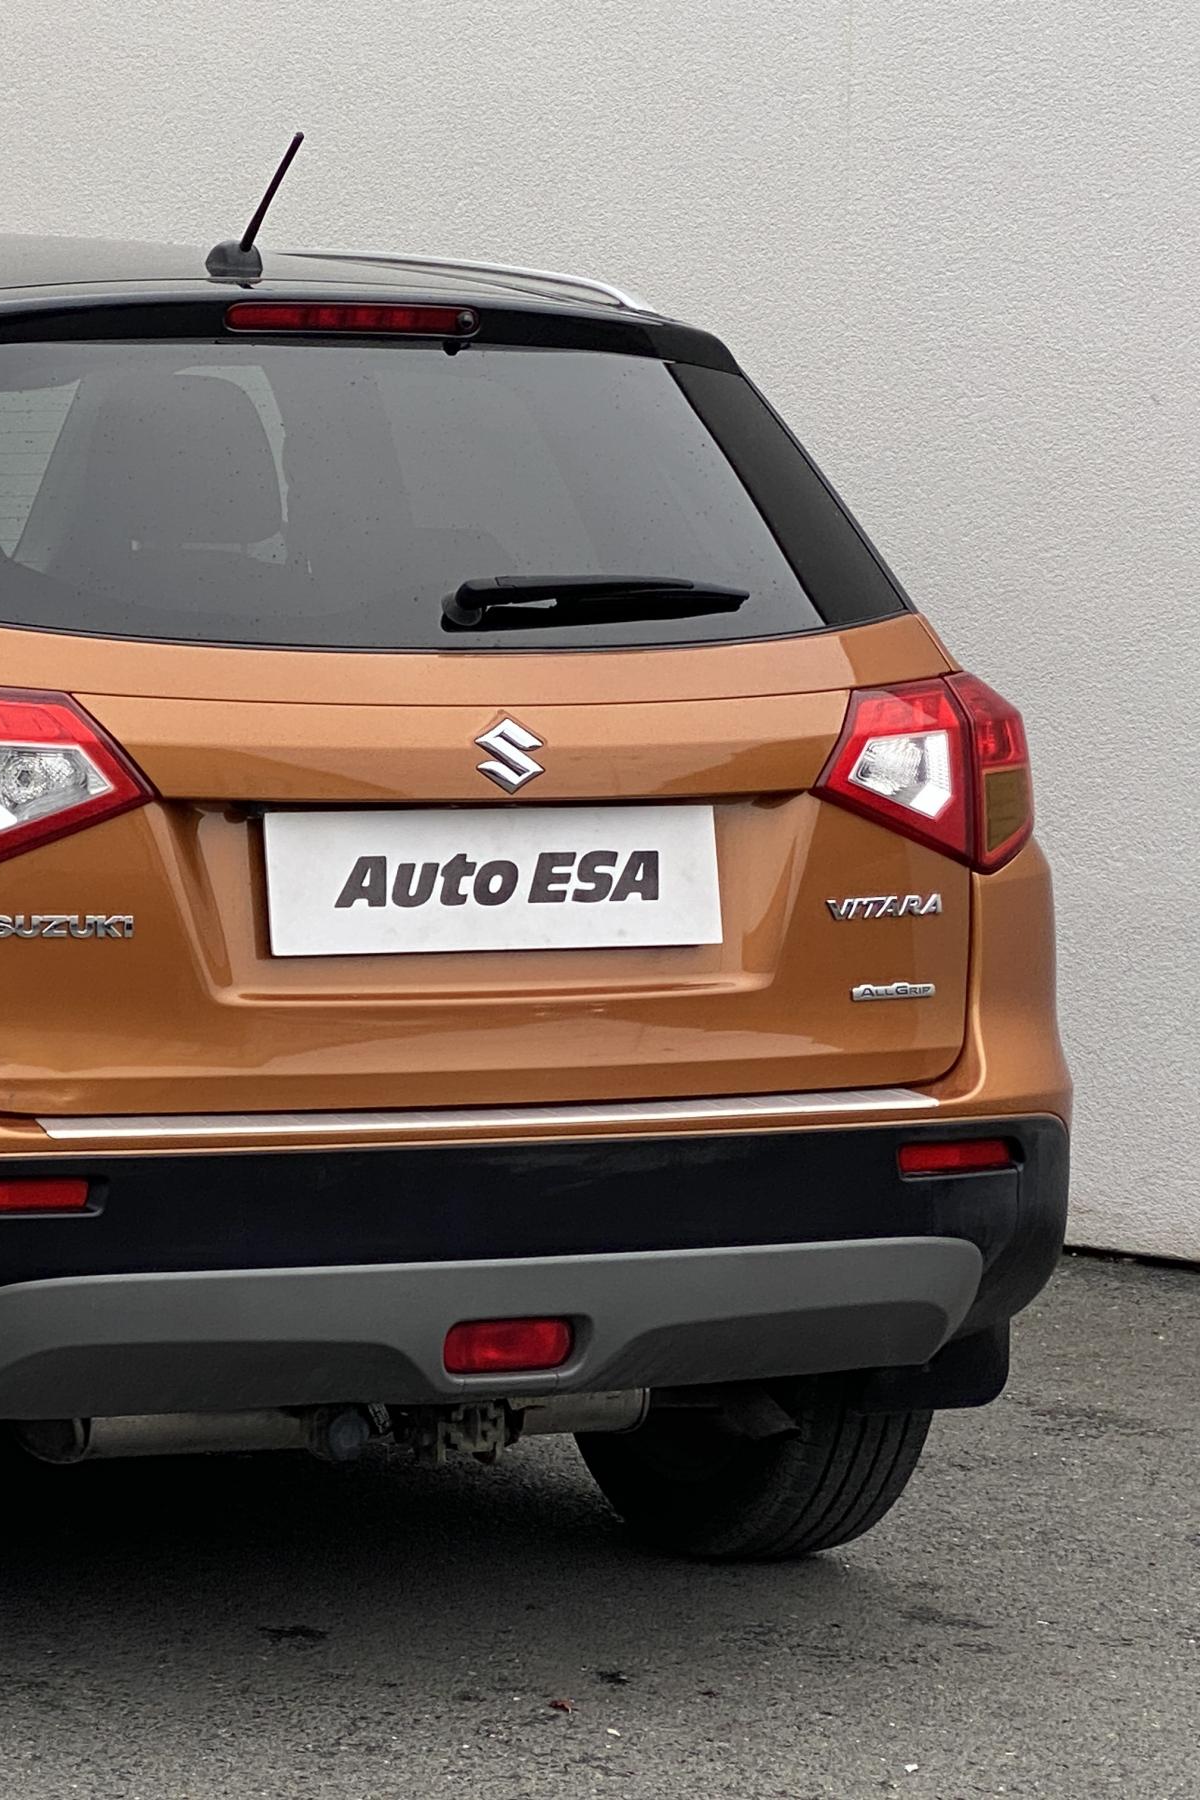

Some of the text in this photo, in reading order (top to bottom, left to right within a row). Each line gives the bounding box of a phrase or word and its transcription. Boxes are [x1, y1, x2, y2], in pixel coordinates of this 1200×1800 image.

[334, 850, 659, 908] Auto ESA
[825, 893, 943, 921] VITARA
